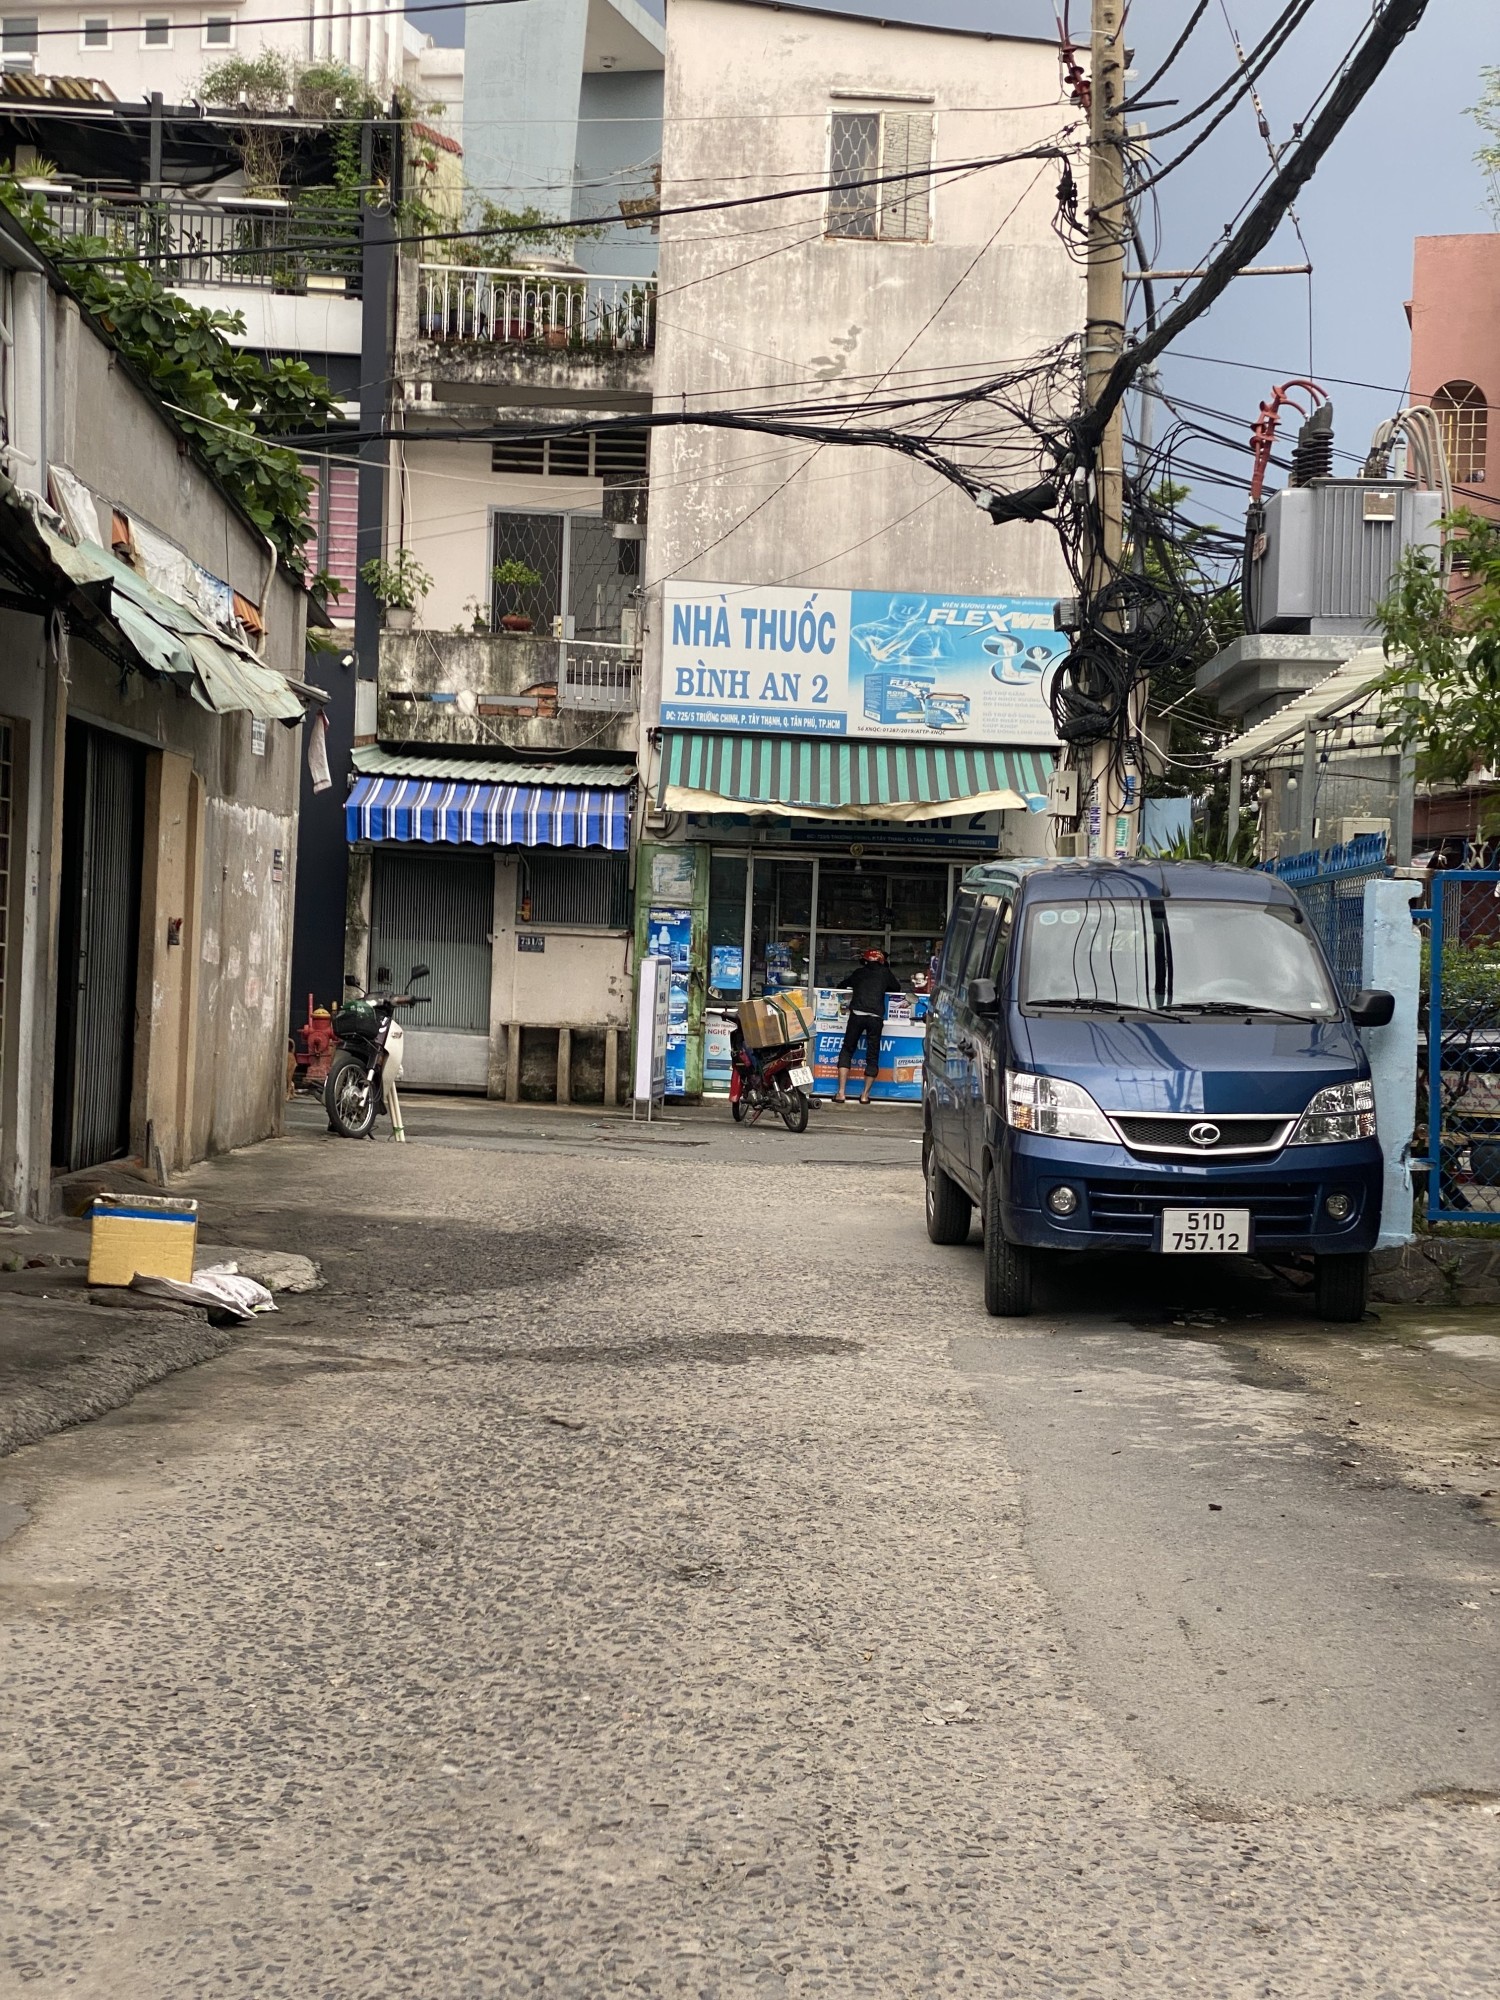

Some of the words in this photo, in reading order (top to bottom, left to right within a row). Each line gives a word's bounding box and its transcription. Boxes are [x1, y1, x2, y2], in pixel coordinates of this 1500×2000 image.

[672, 594, 731, 648] NHÀ
[740, 592, 836, 655] THUỐC
[675, 659, 750, 699] BÌNH
[759, 672, 801, 702] AN
[811, 674, 828, 703] 2
[677, 711, 695, 722] 725/5
[741, 714, 747, 724] P.
[748, 712, 760, 725] TÂY
[761, 715, 782, 727] THẠNH,
[783, 716, 789, 727] Q.
[790, 715, 803, 727] TÂN
[818, 719, 841, 729] TP.HCM
[1188, 1212, 1225, 1231] 51D
[1172, 1232, 1239, 1250] 757.12
